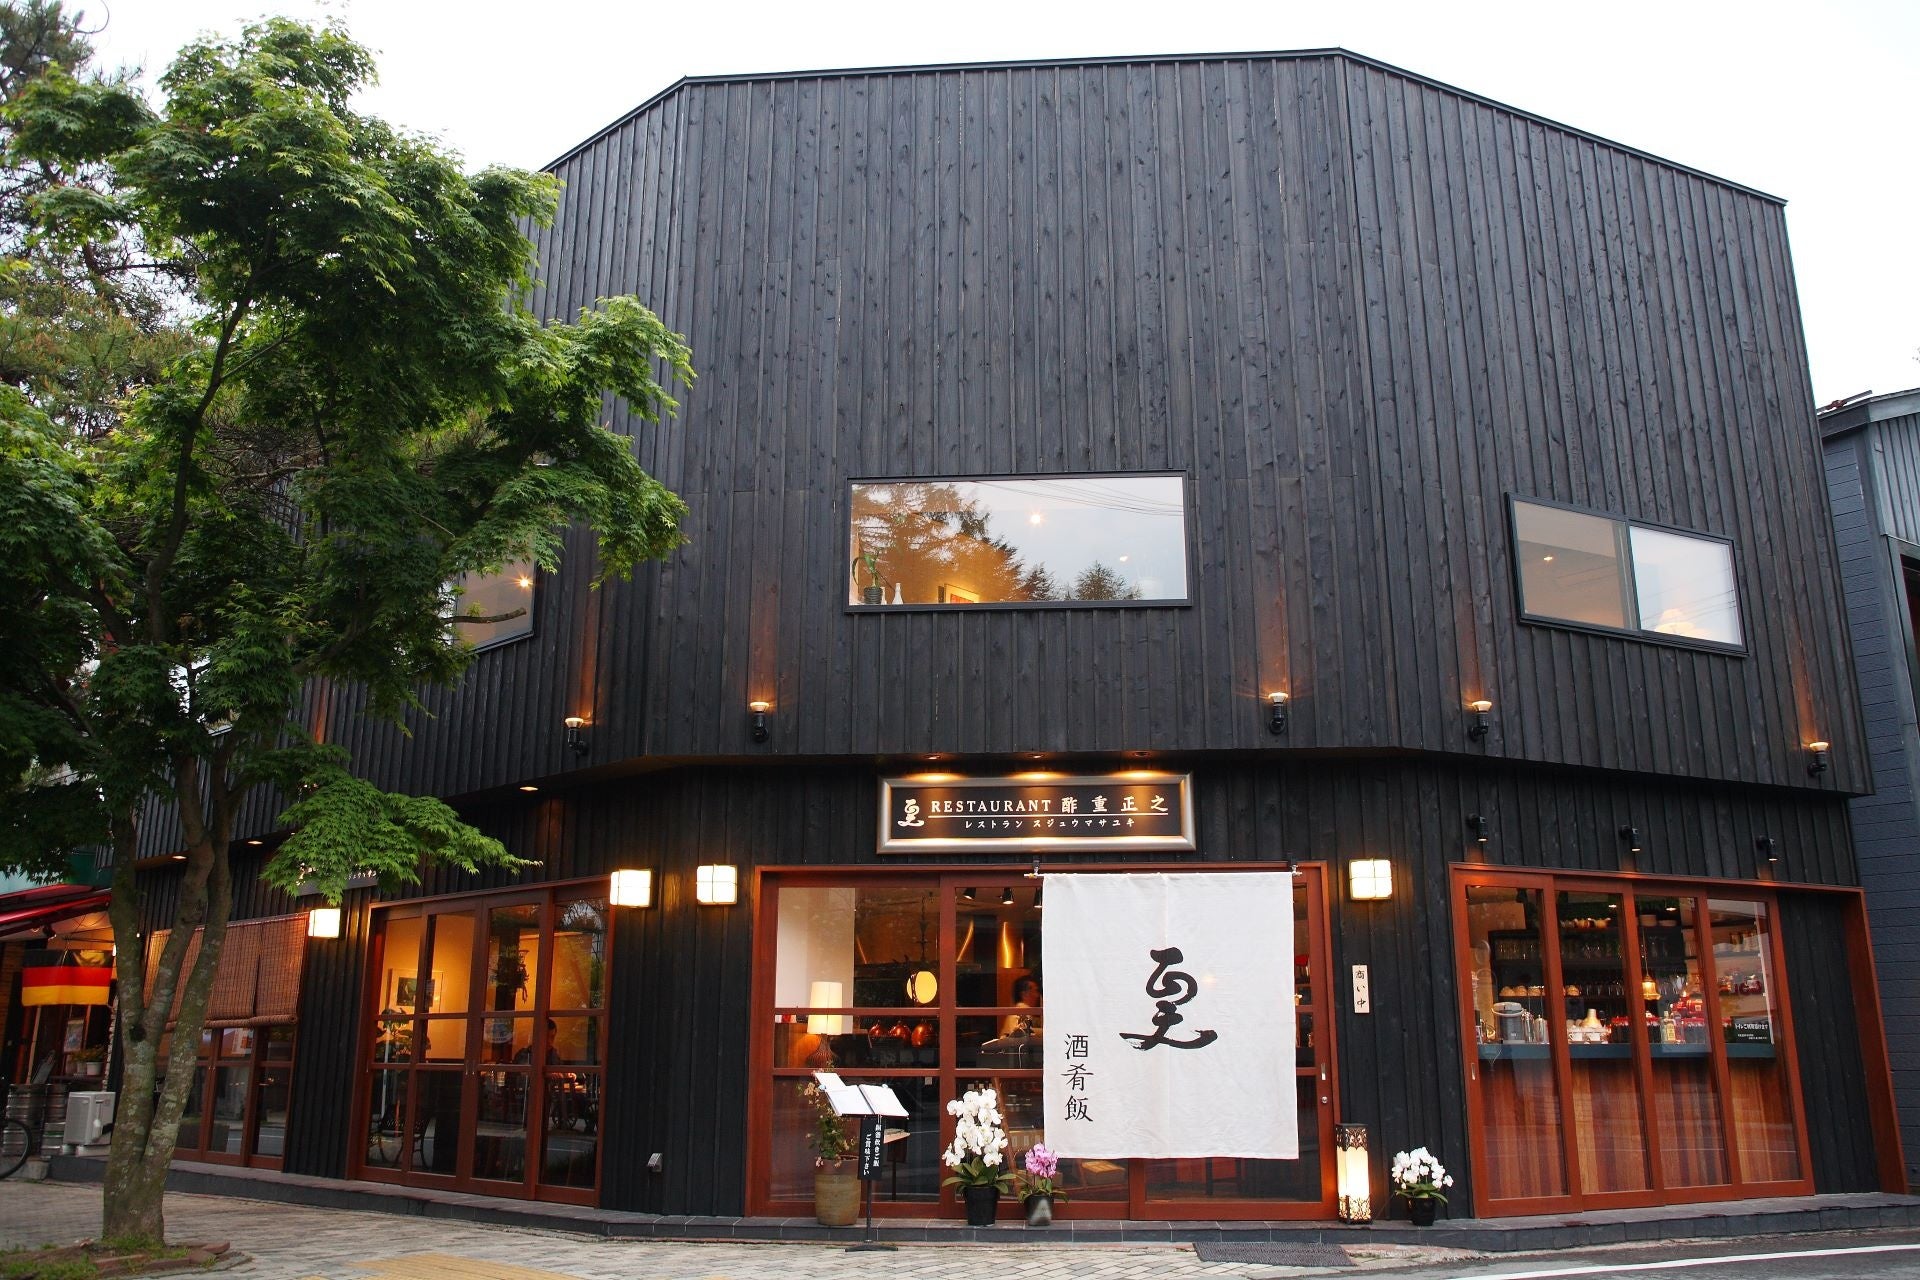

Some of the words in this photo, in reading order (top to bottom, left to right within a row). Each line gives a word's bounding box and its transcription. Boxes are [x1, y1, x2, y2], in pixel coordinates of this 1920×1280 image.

[931, 800, 1052, 813] RESTAURANT
[1061, 795, 1169, 814] 酢重正之
[965, 820, 1024, 829] レストラン
[1033, 818, 1135, 828] スジュウマサユキ
[1060, 1033, 1094, 1122] 酒肴飯
